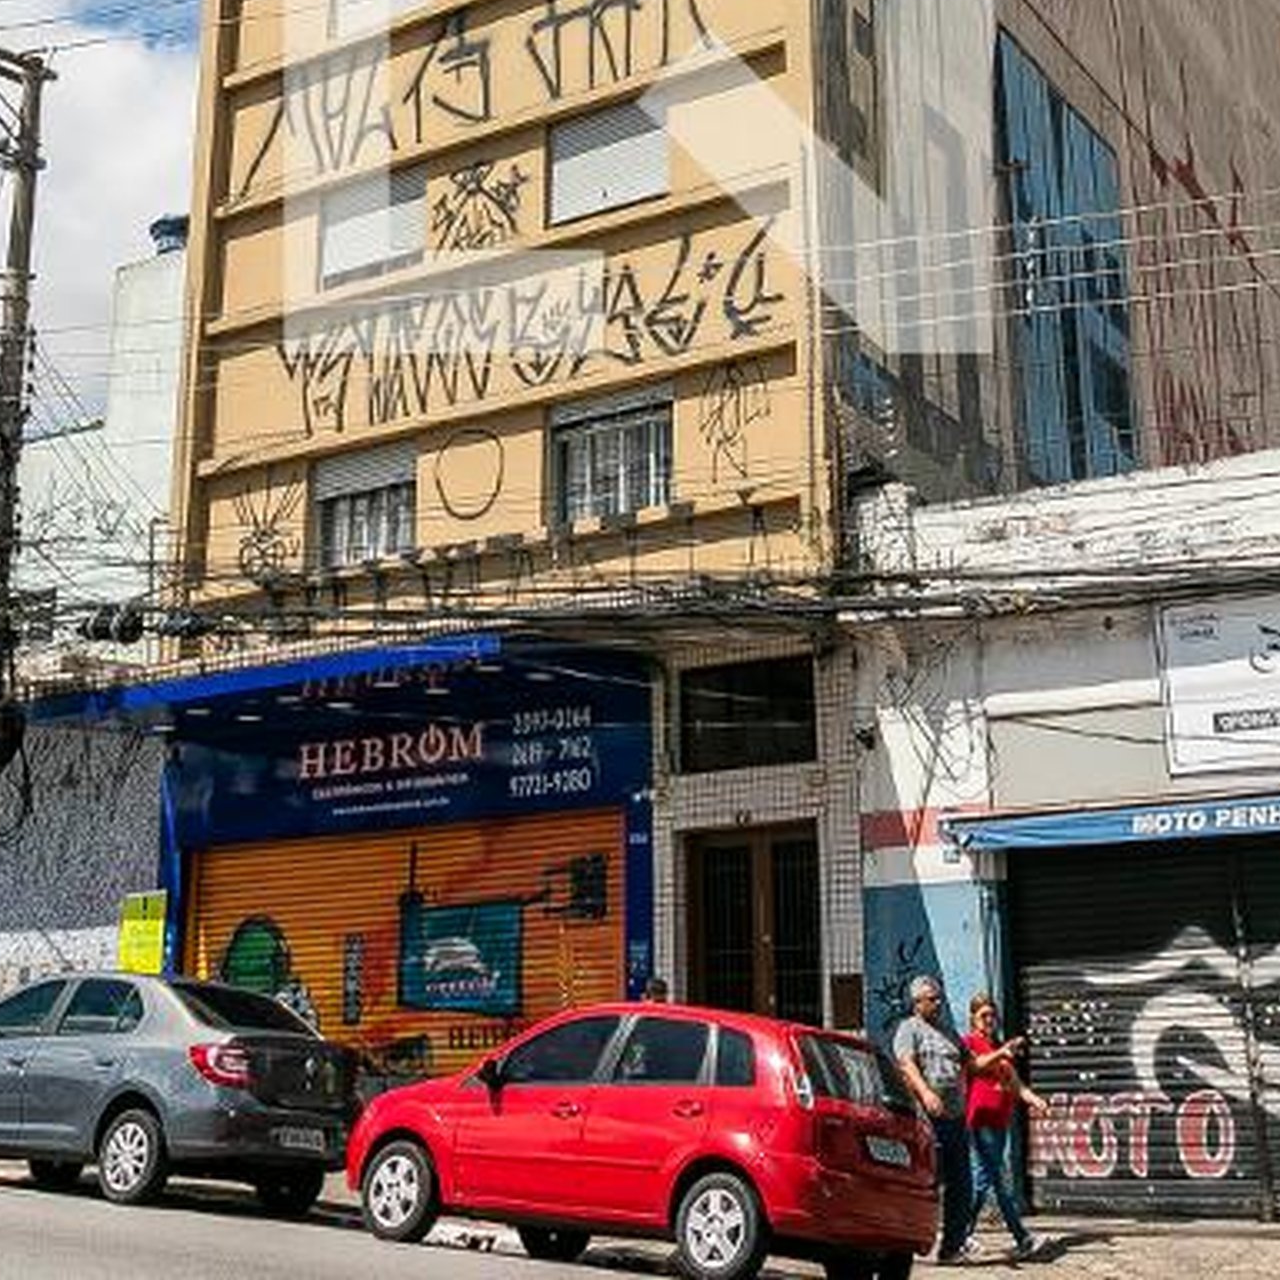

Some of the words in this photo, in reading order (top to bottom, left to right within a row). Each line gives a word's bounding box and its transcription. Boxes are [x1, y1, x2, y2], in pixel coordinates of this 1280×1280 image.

[298, 723, 484, 780] HEBROM
[1132, 809, 1207, 835] MOTO
[1029, 1088, 1236, 1179] MOTO
